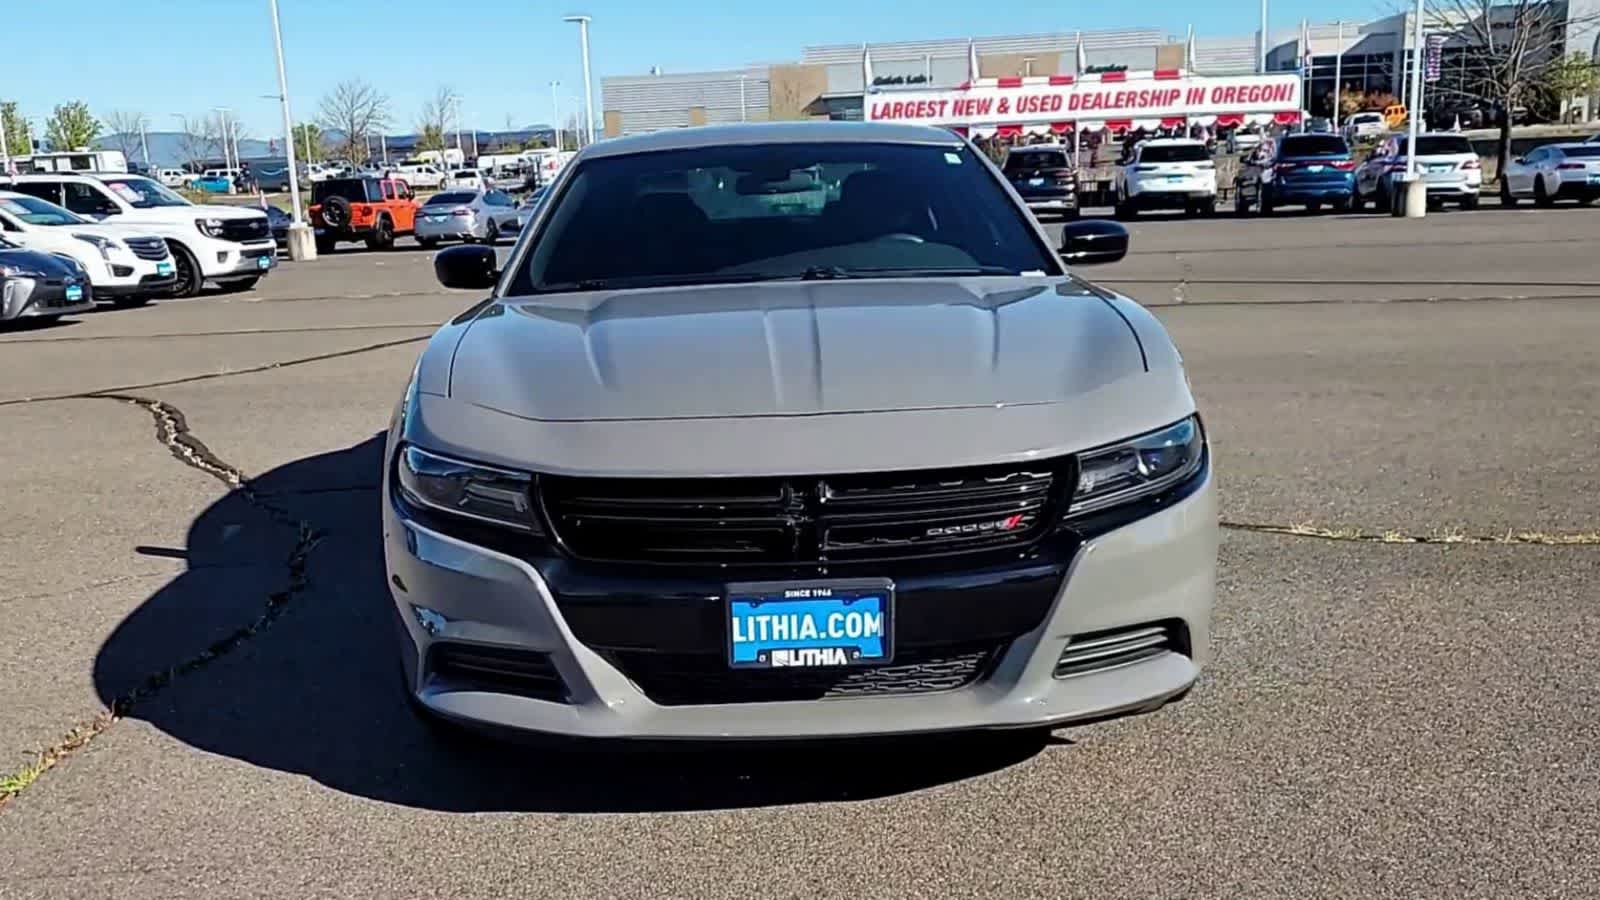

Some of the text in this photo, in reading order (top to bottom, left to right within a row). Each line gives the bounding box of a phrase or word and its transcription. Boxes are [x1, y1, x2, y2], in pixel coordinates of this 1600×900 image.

[870, 83, 1295, 120] LARGEST NEW & USED DEALERSHIP IN OREGON!
[784, 589, 811, 599] SINCE
[732, 611, 884, 643] LITHIA.COM
[789, 647, 848, 667] LITHIA
